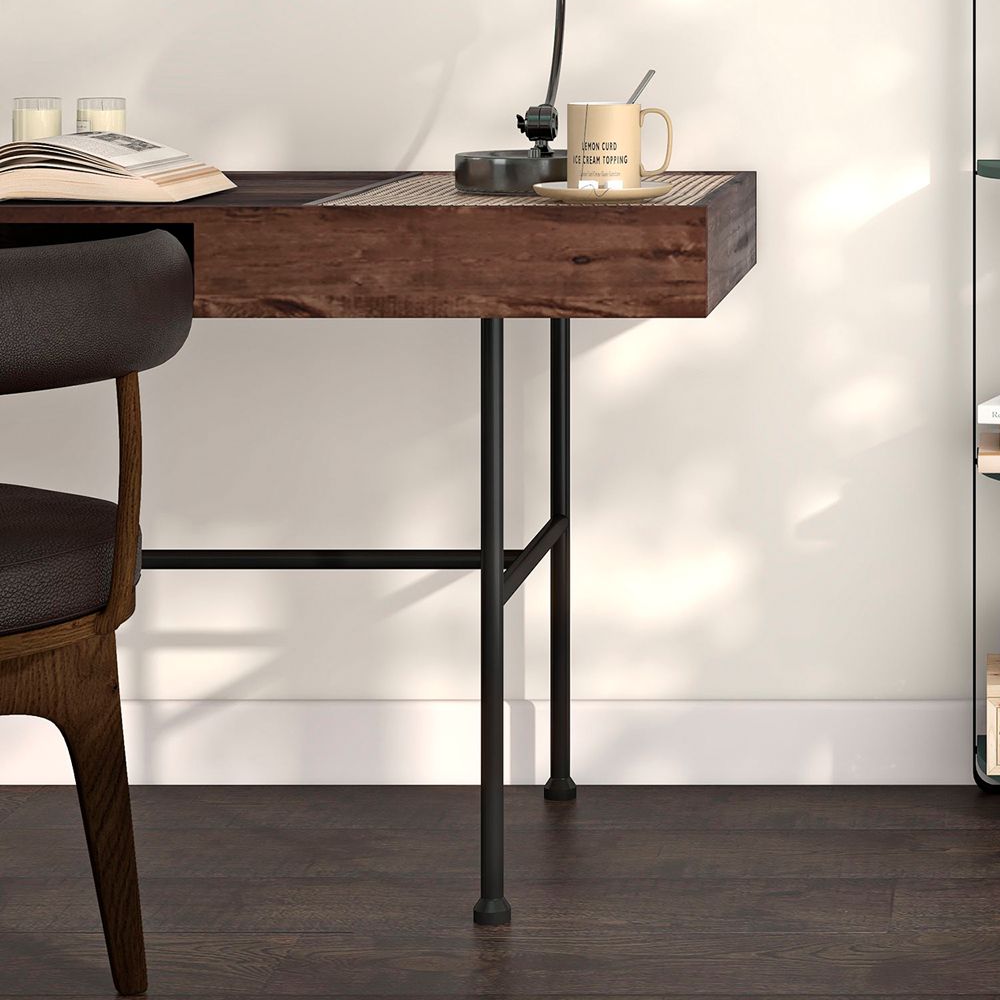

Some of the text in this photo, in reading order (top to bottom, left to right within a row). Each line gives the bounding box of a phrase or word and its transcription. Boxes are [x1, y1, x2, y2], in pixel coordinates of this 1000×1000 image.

[581, 142, 618, 151] LEMON CURD
[573, 155, 628, 165] ICE CREAM TOPPING
